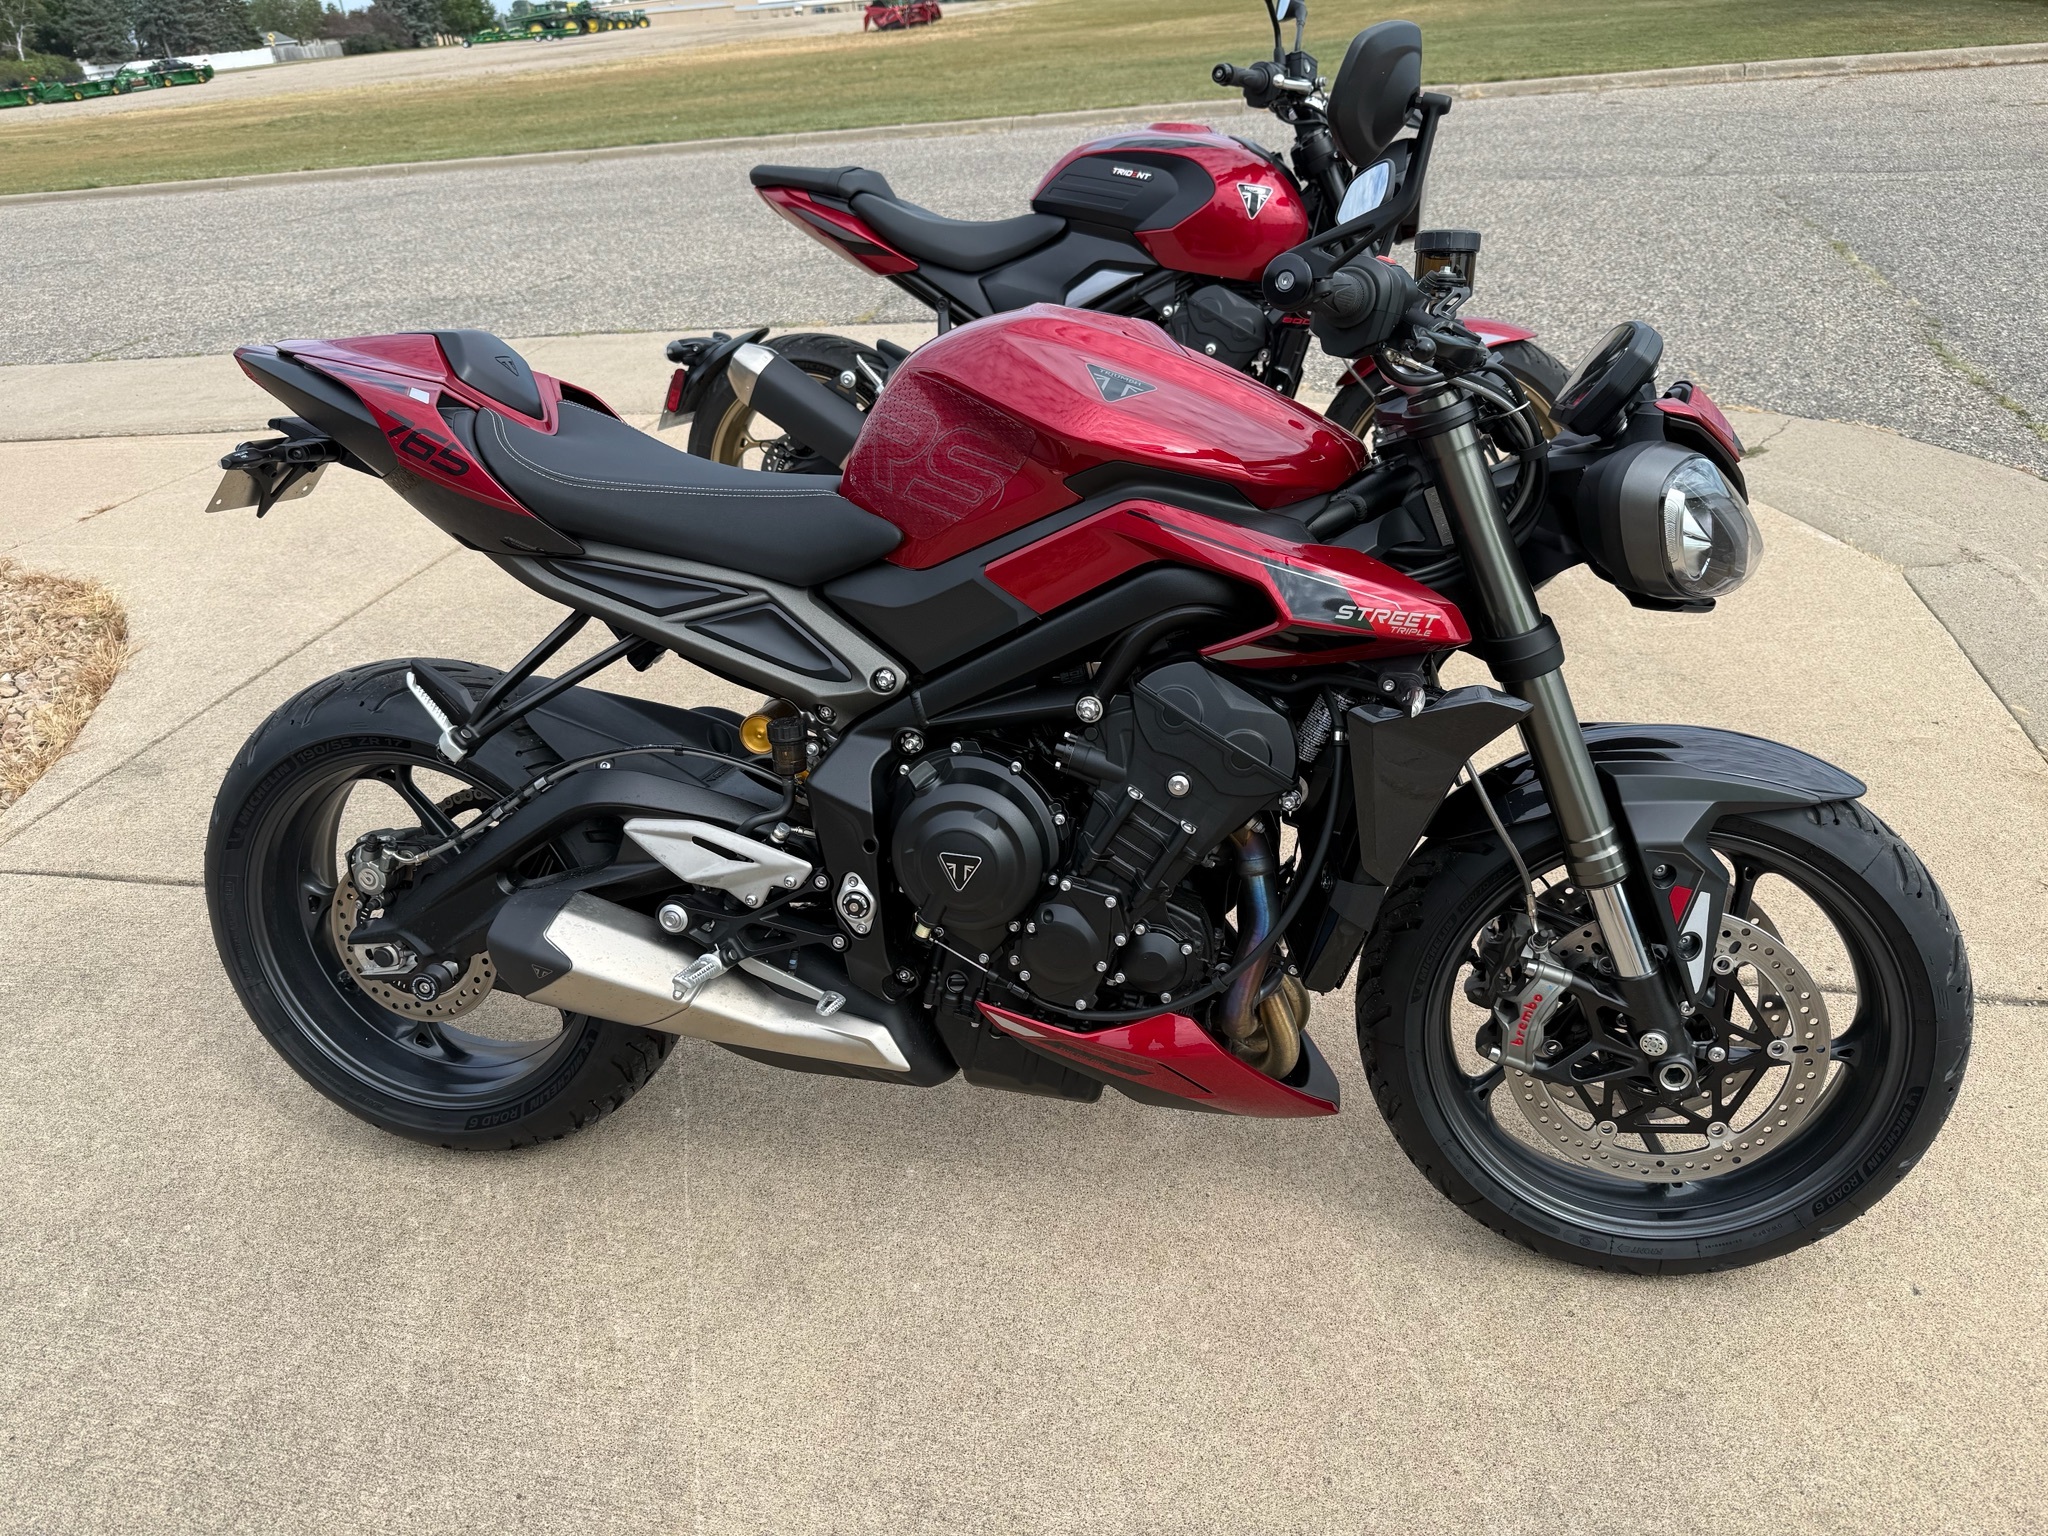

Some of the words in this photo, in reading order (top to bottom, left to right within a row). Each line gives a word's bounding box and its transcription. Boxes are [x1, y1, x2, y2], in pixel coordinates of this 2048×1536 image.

[1112, 166, 1153, 181] TRIDENT
[1099, 368, 1142, 386] TRIUMPH
[386, 409, 471, 476] 765
[1334, 604, 1442, 629] STREET
[1390, 626, 1433, 637] TRIPLE
[241, 762, 292, 827] MICHELIN
[296, 738, 354, 764] 190/55
[357, 735, 381, 747] ZR
[384, 737, 404, 748] 17
[1420, 918, 1455, 982] MICHELIN
[1510, 993, 1544, 1047] brembo
[530, 1054, 584, 1111] MICHELIN
[468, 1120, 479, 1129] 6
[482, 1107, 518, 1126] ROAD
[1866, 1108, 1912, 1171] MICHELIN
[1826, 1174, 1860, 1205] ROAD
[1815, 1202, 1825, 1213] 6
